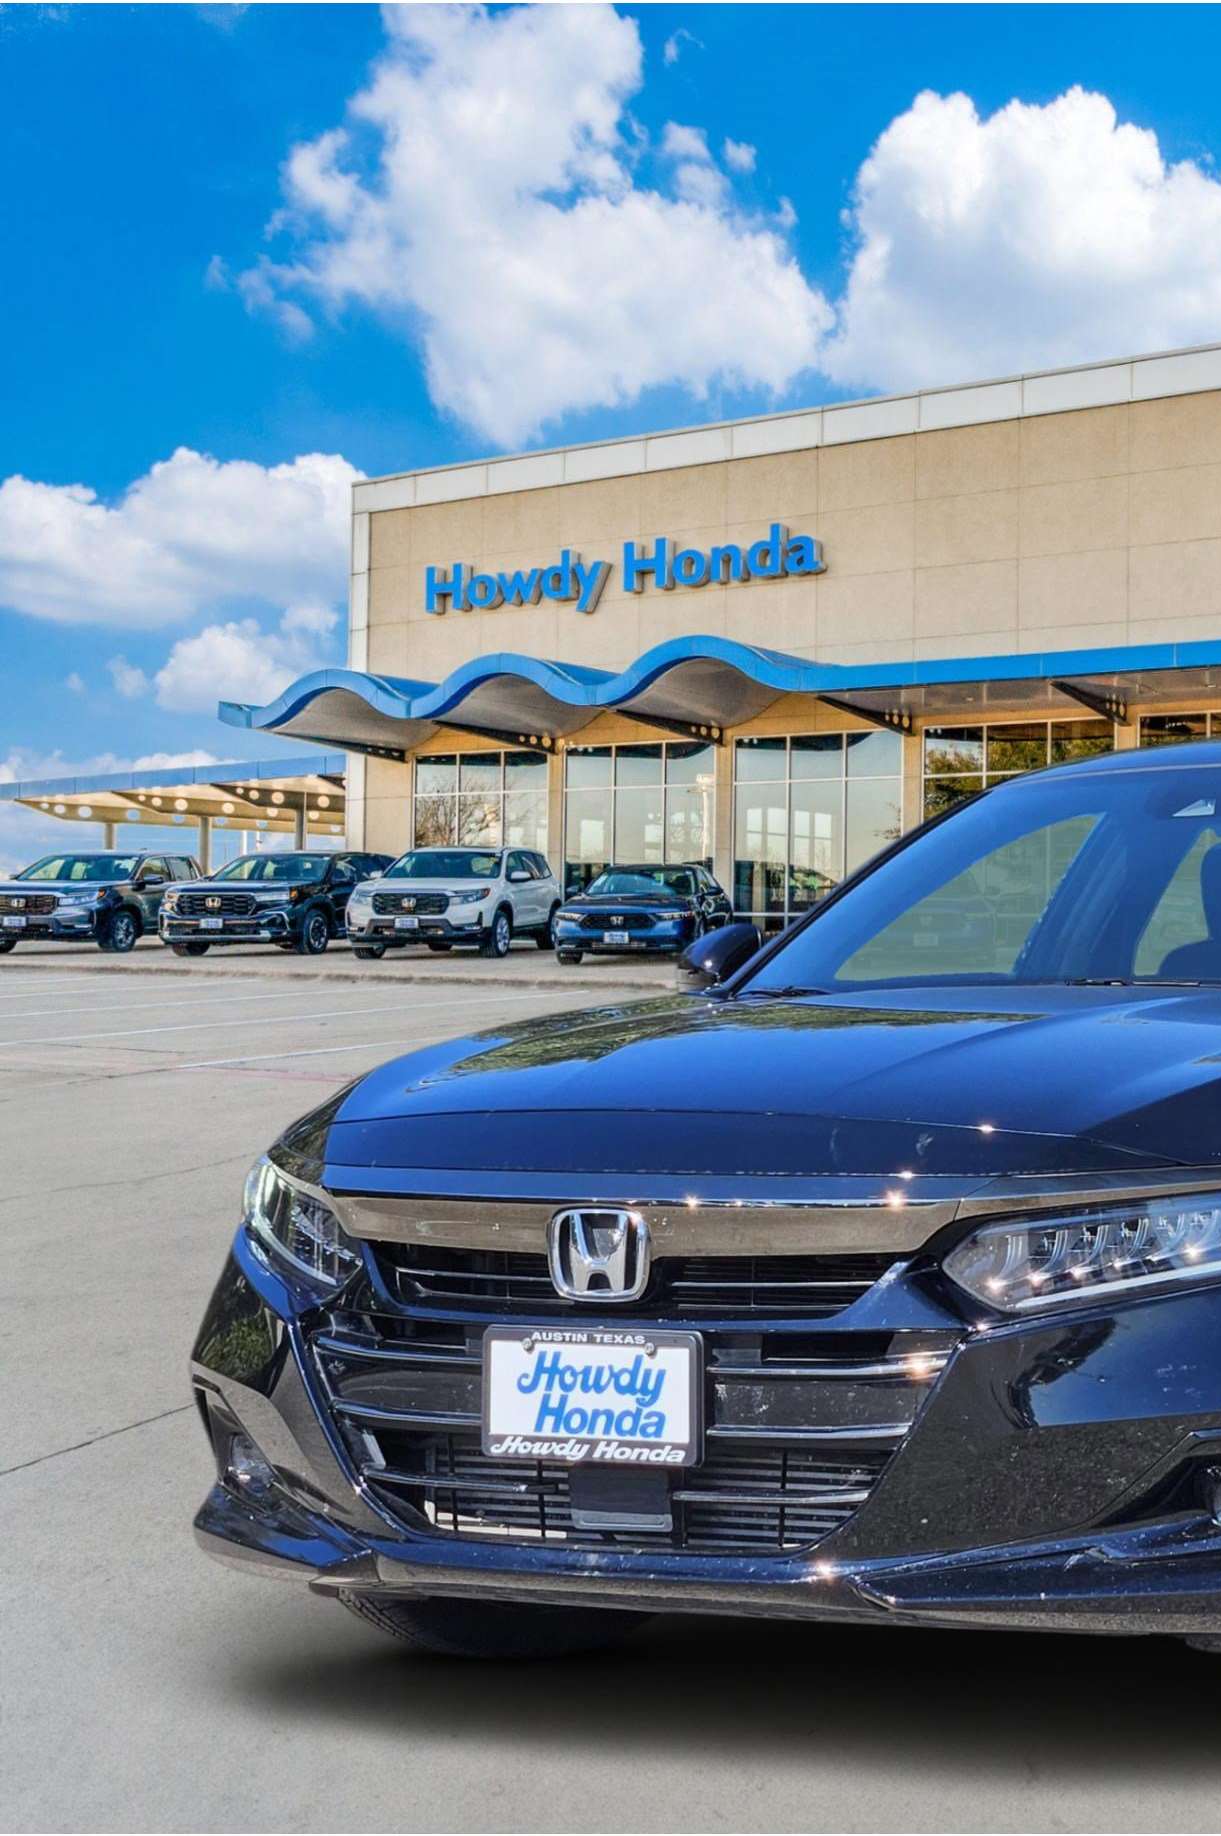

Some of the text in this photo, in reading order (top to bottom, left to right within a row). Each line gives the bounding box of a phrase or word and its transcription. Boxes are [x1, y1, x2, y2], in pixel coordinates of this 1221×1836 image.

[425, 523, 827, 614] Howdy Honda
[531, 1331, 646, 1345] AUSTIN TEXAS
[517, 1350, 666, 1406] Howdy
[534, 1394, 666, 1438] Honda
[490, 1435, 686, 1463] Howdy Honda
